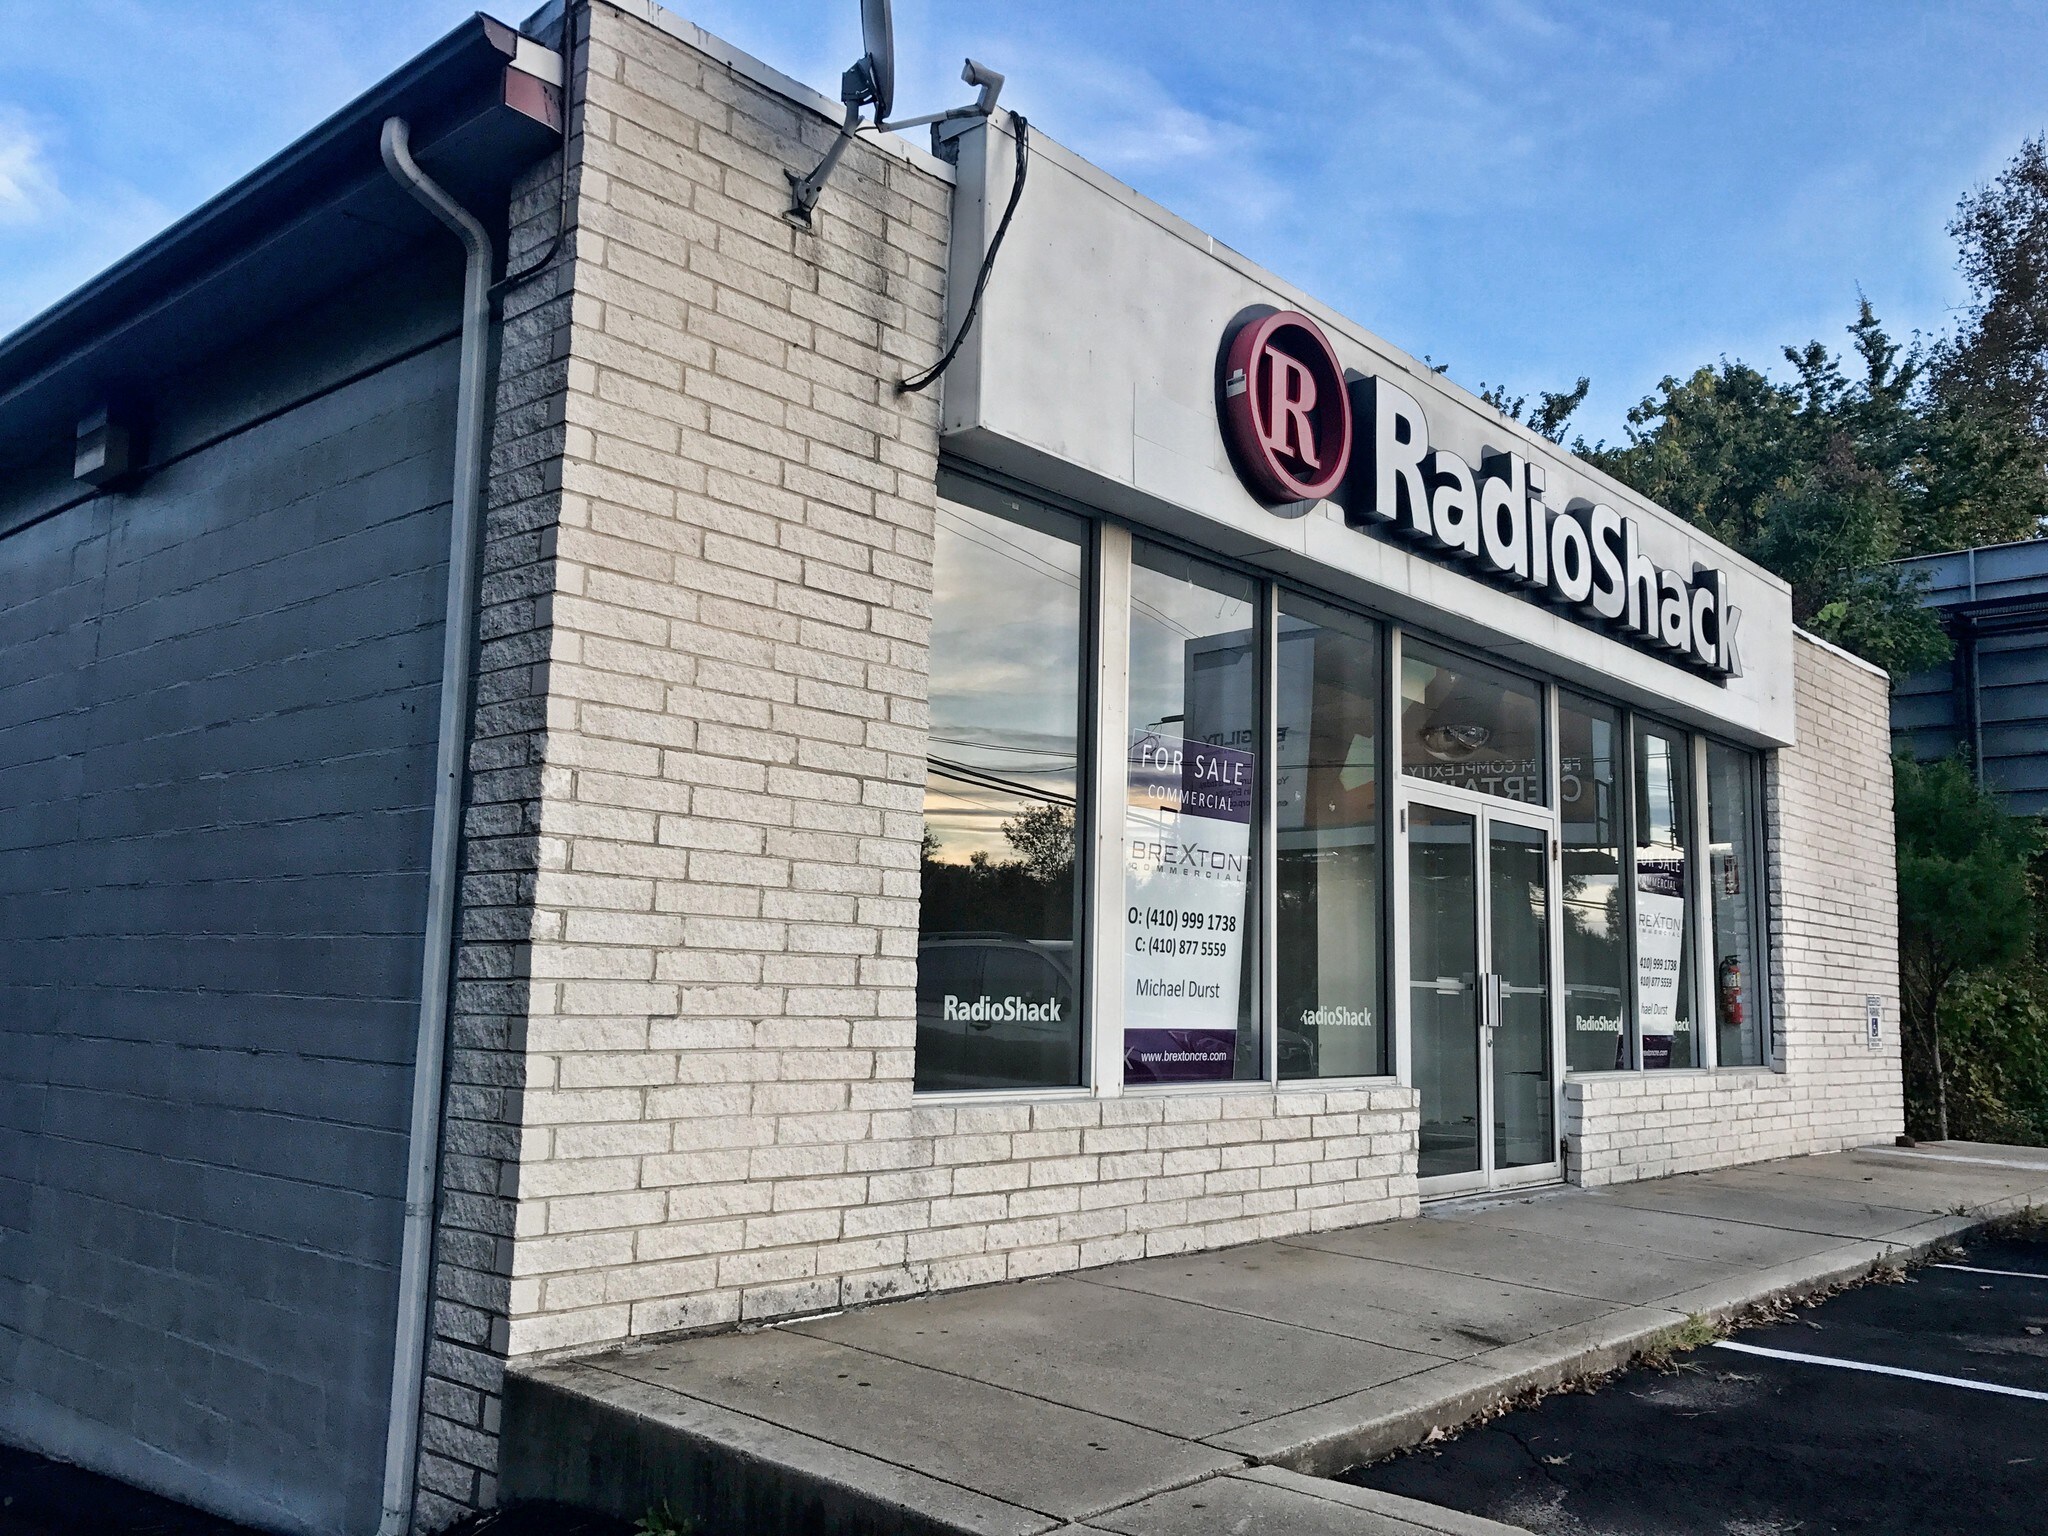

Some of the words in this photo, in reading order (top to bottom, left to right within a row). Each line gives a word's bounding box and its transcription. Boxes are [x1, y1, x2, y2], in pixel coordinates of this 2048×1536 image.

[1265, 344, 1322, 470] R
[1375, 374, 1743, 680] RadioShack
[1142, 744, 1183, 774] FOR
[1194, 754, 1244, 785] SALE
[1148, 784, 1233, 811] COMMERCIAL
[1132, 840, 1242, 872] BREXTON
[1658, 854, 1680, 872] SALE
[1131, 862, 1241, 881] COMMERCIAL
[1128, 907, 1142, 924] O:
[1146, 907, 1178, 931] (410)
[1182, 911, 1204, 929] 999
[1207, 914, 1236, 932] 1738
[1638, 913, 1680, 931] REXTON
[1135, 937, 1145, 952] C:
[1149, 936, 1176, 957] (410)
[1179, 940, 1198, 955] 877
[1201, 942, 1226, 956] 5559
[1640, 957, 1652, 971] 410)
[1653, 958, 1663, 970] 999
[1664, 959, 1677, 971] 1738
[1136, 978, 1185, 997] Michael
[1188, 980, 1220, 998] Durst
[1640, 976, 1651, 988] 410)
[943, 994, 1062, 1022] RadioShack
[1641, 1002, 1653, 1015] hael
[1653, 1003, 1668, 1015] Durst
[1141, 1050, 1227, 1062] www.brextoncre.com
